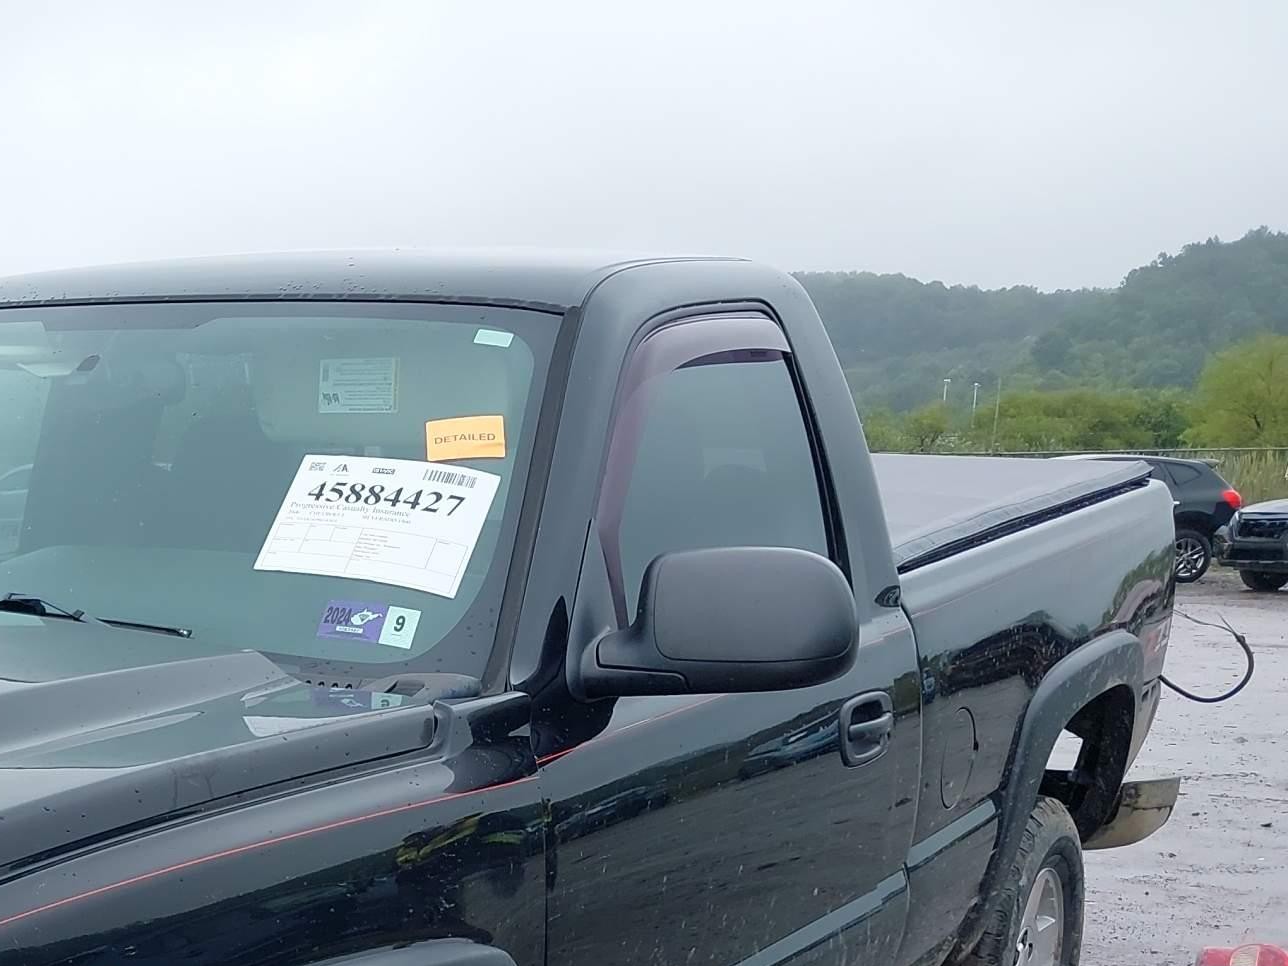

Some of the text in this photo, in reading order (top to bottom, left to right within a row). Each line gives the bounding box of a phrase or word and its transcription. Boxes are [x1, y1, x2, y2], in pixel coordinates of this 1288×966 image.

[434, 433, 496, 445] DETAILED
[307, 480, 466, 517] 45884427
[290, 501, 333, 512] Progressive
[336, 505, 369, 514] Casualty
[372, 508, 410, 518] Insurance
[323, 606, 352, 626] 2024
[393, 615, 406, 632] 9
